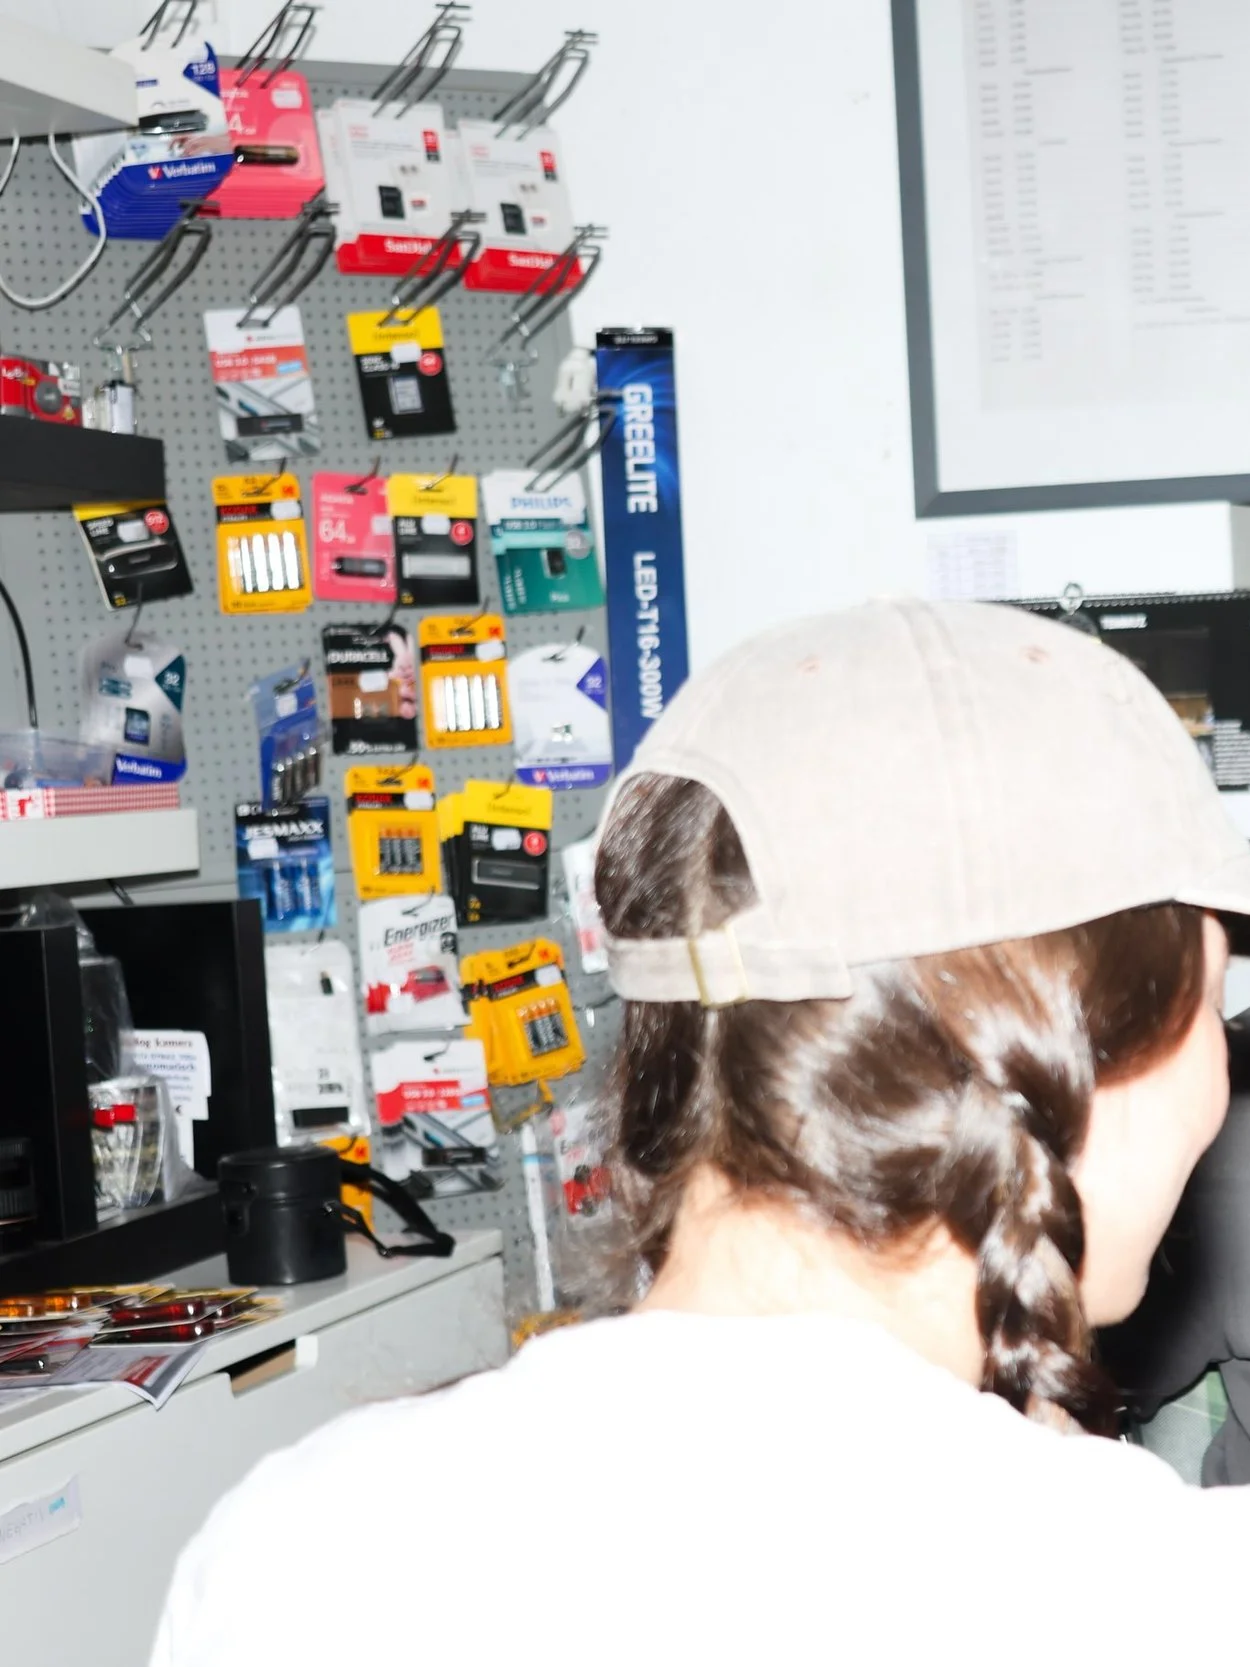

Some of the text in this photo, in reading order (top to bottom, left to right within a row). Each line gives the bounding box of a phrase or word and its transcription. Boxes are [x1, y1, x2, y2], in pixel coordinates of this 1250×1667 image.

[162, 161, 216, 179] Verbatim
[624, 383, 658, 514] GREELITE
[511, 496, 573, 510] PHILIPS
[319, 518, 346, 543] 64
[327, 649, 389, 664] DURACELL
[115, 758, 162, 779] Verbatim
[546, 768, 595, 782] Verbatim
[384, 913, 455, 947] Energizer
